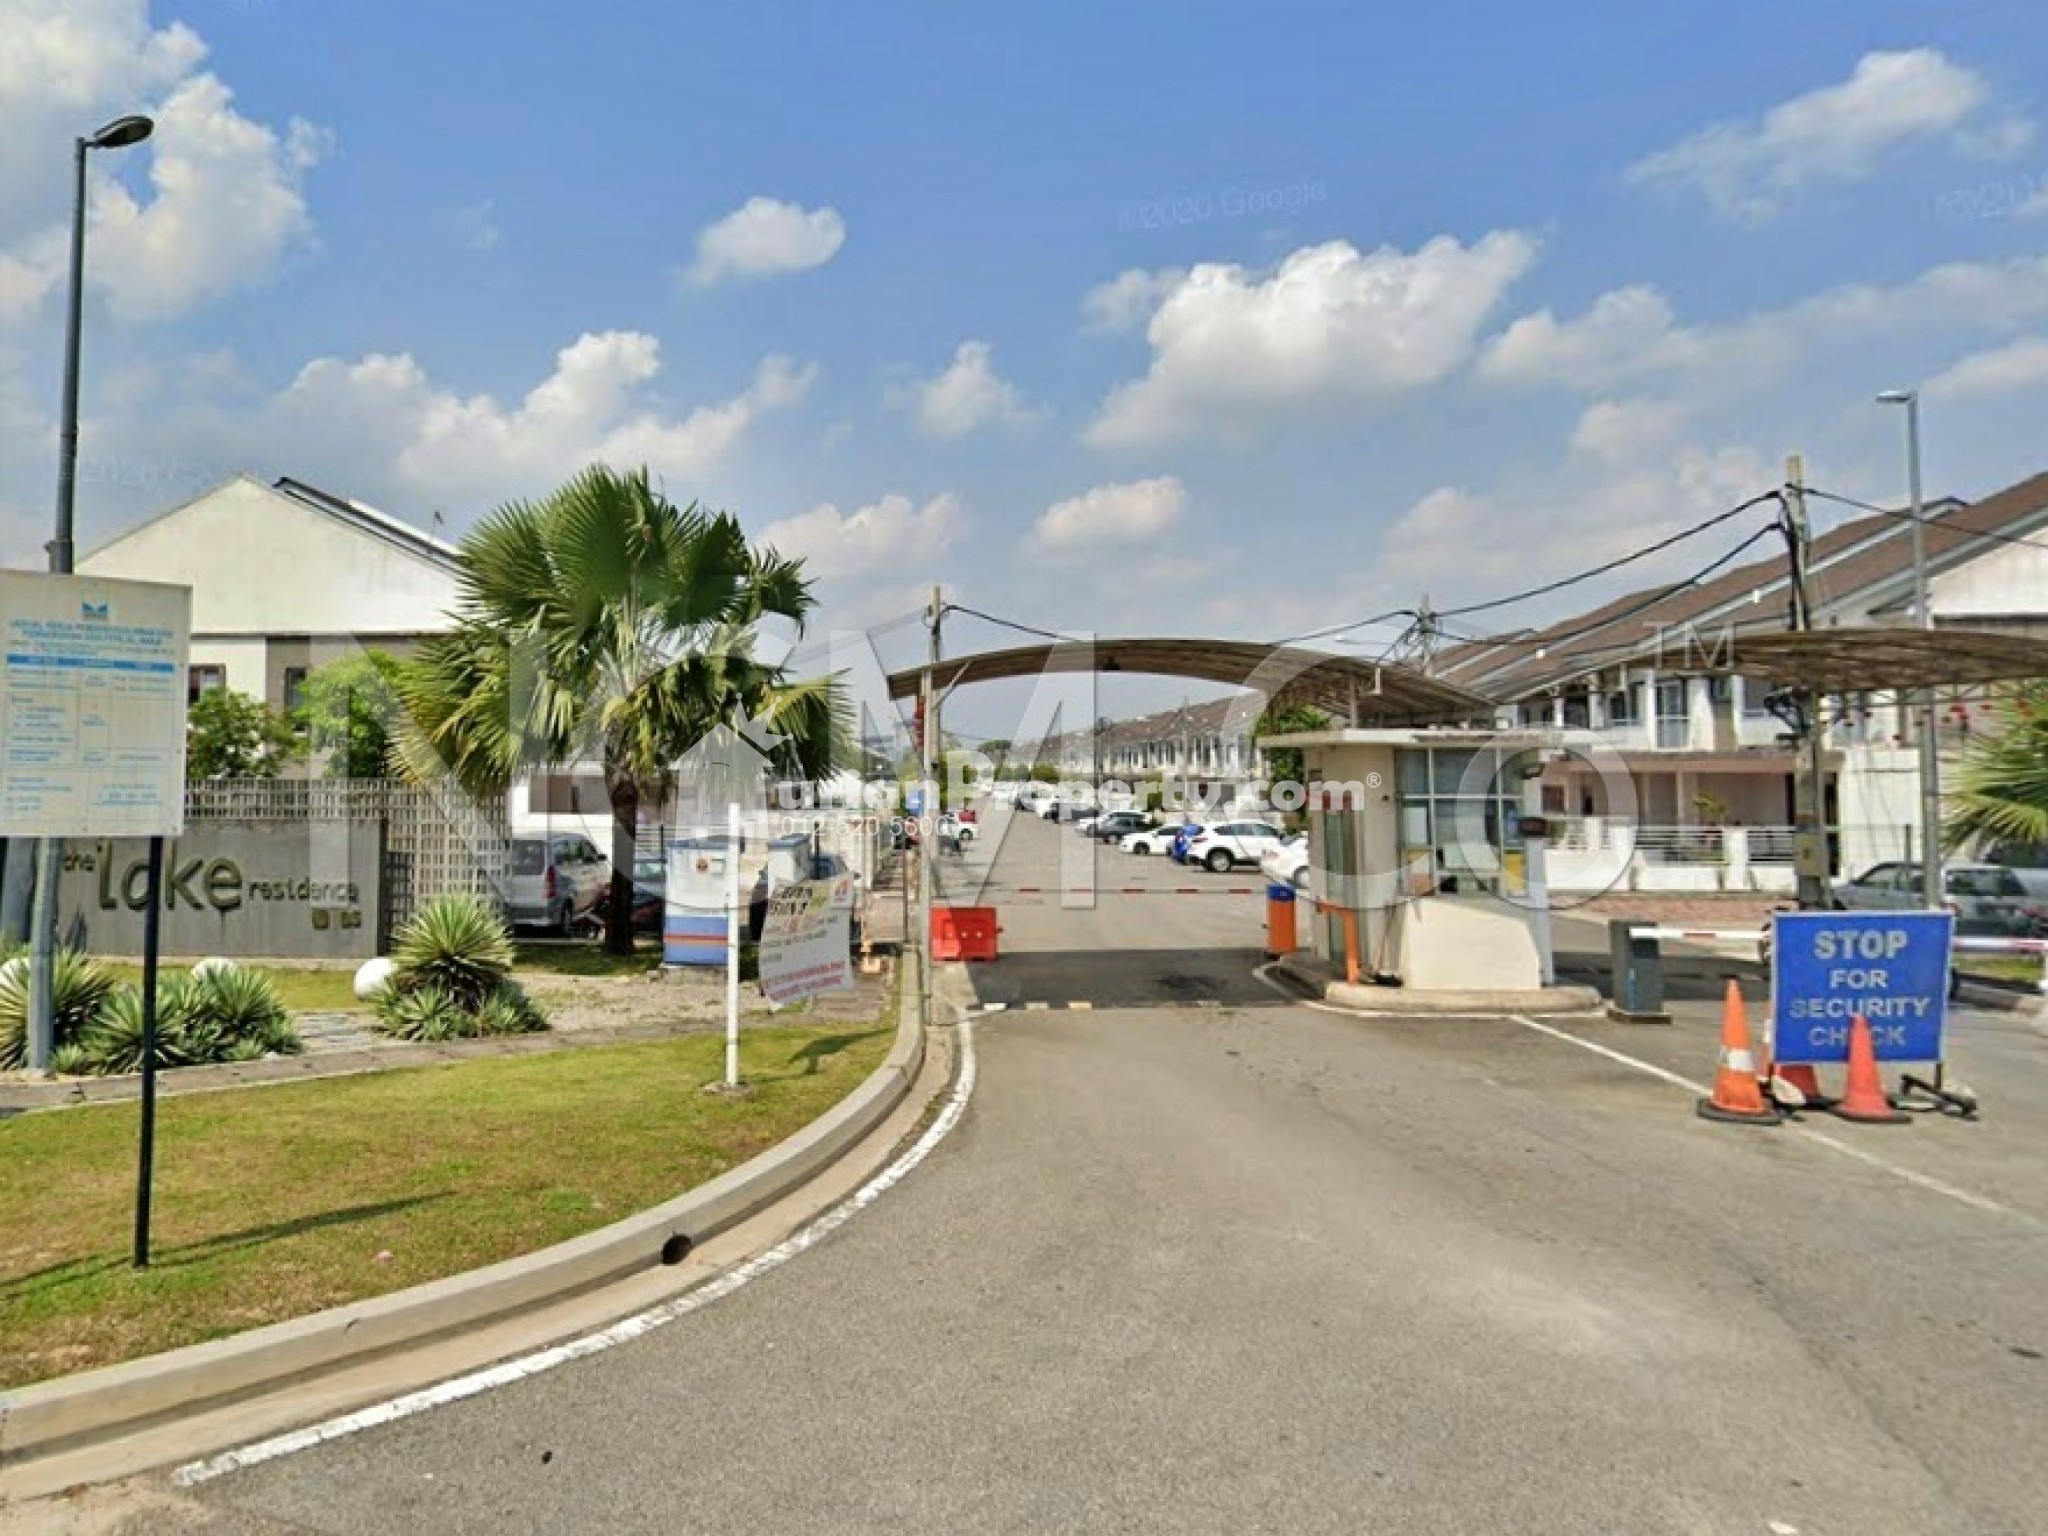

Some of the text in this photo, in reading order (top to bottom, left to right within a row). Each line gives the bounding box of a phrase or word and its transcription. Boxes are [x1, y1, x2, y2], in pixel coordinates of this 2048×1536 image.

[1813, 929, 1908, 960] STOP
[1829, 969, 1889, 990] FOR
[1789, 997, 1930, 1018] SECURITY
[1808, 1026, 1906, 1046] CHCK
